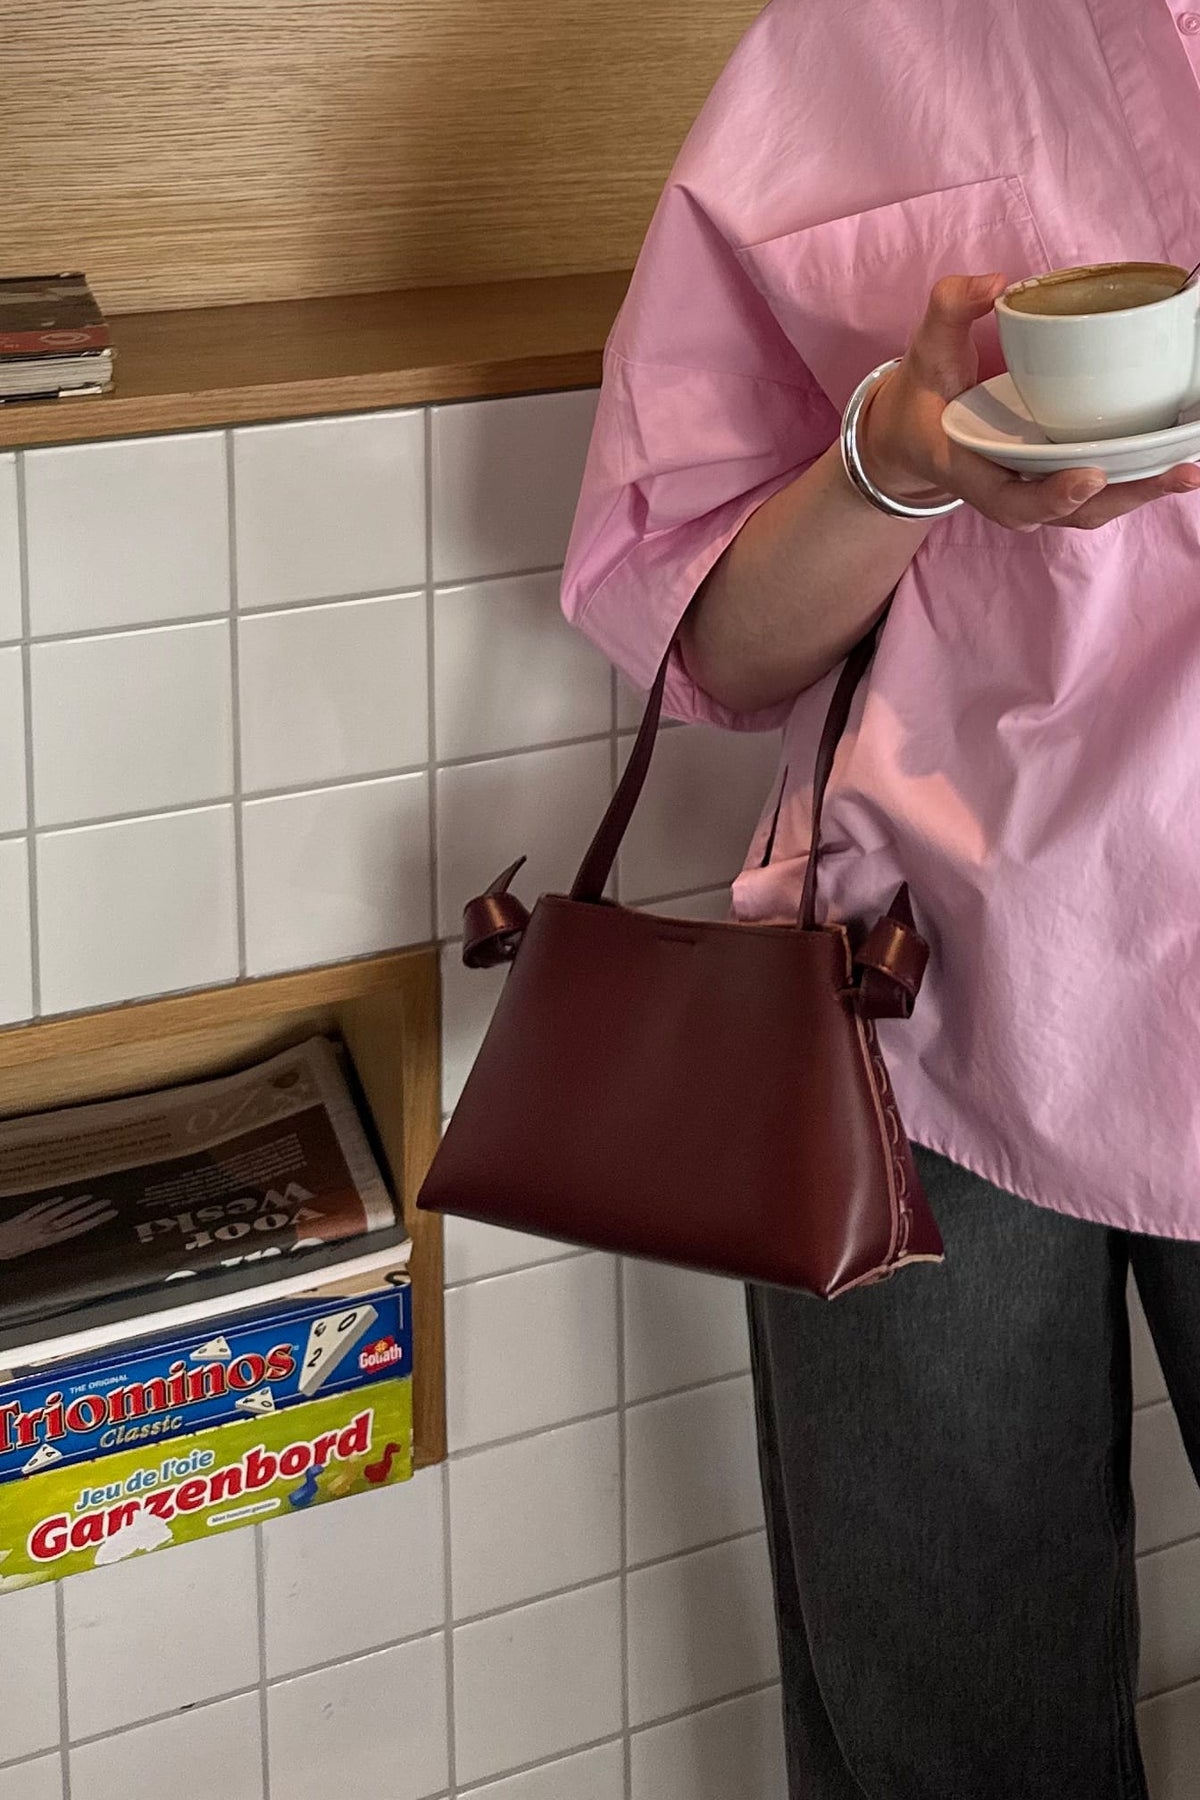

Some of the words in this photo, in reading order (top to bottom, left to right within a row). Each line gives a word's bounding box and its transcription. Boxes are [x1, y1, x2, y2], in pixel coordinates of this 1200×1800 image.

[185, 1207, 326, 1250] voor
[359, 1344, 402, 1369] Goliath
[69, 1383, 87, 1395] THE
[88, 1374, 129, 1390] ORIGINAL
[100, 1414, 184, 1449] Classic
[30, 1409, 373, 1559] Ganzenbord
[77, 1482, 121, 1511] Jeu
[127, 1469, 157, 1493] de
[162, 1450, 214, 1481] l'oie
